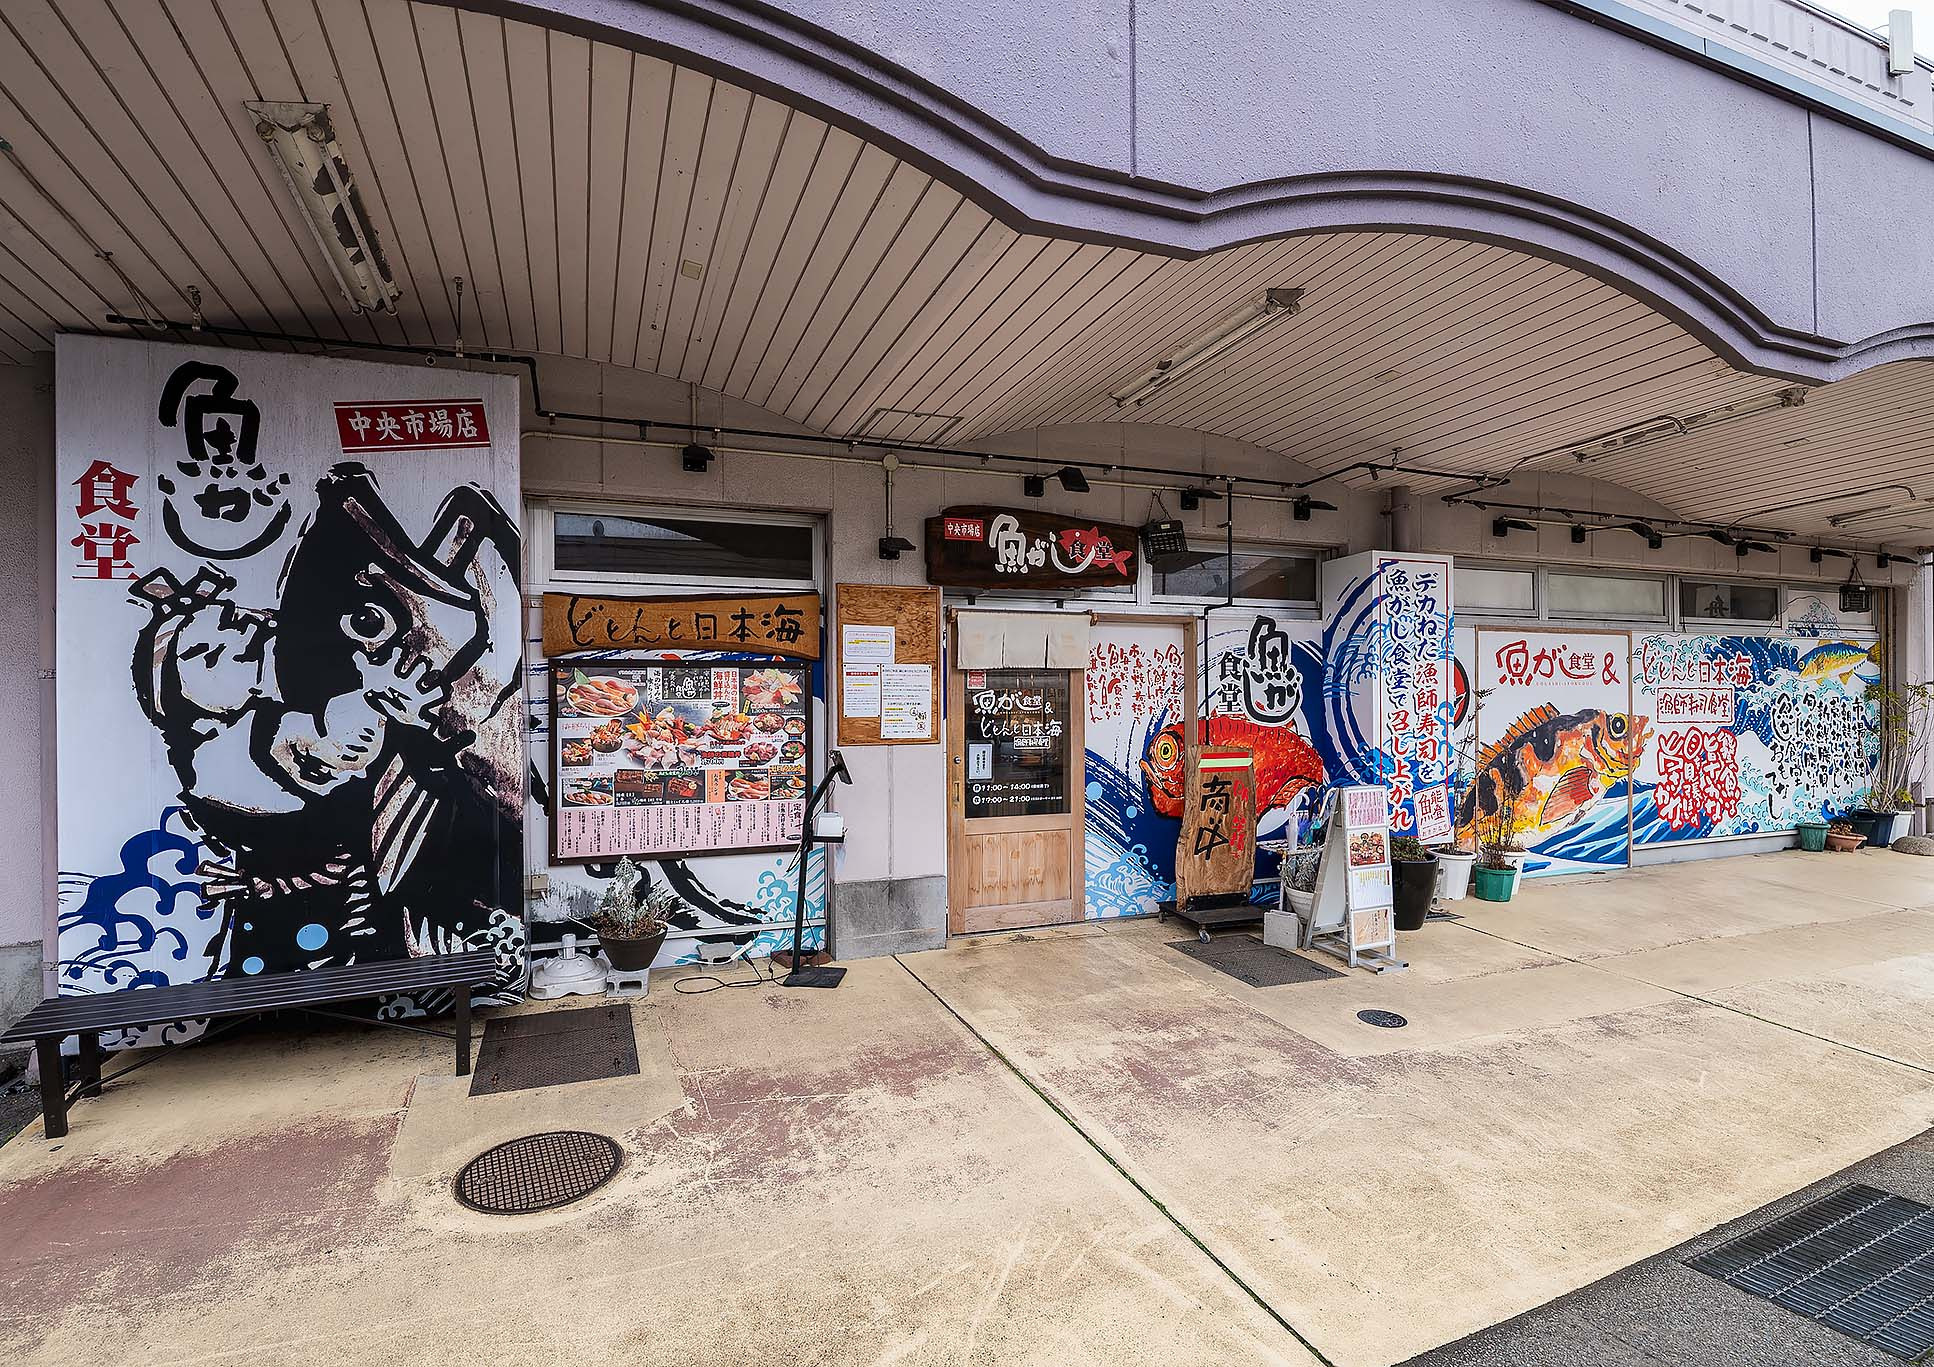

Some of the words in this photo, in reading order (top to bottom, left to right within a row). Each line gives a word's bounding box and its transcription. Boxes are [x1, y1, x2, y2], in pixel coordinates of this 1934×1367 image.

[348, 409, 478, 441] 中央市場店
[71, 459, 141, 580] 食堂
[948, 523, 981, 537] 中央市場店
[1217, 650, 1243, 712] 食堂
[1414, 572, 1440, 780] デカねた漁師寿司を
[1602, 652, 1621, 685] &
[1044, 701, 1054, 714] &
[1389, 567, 1413, 830] 魚がし食堂で召し上がれ
